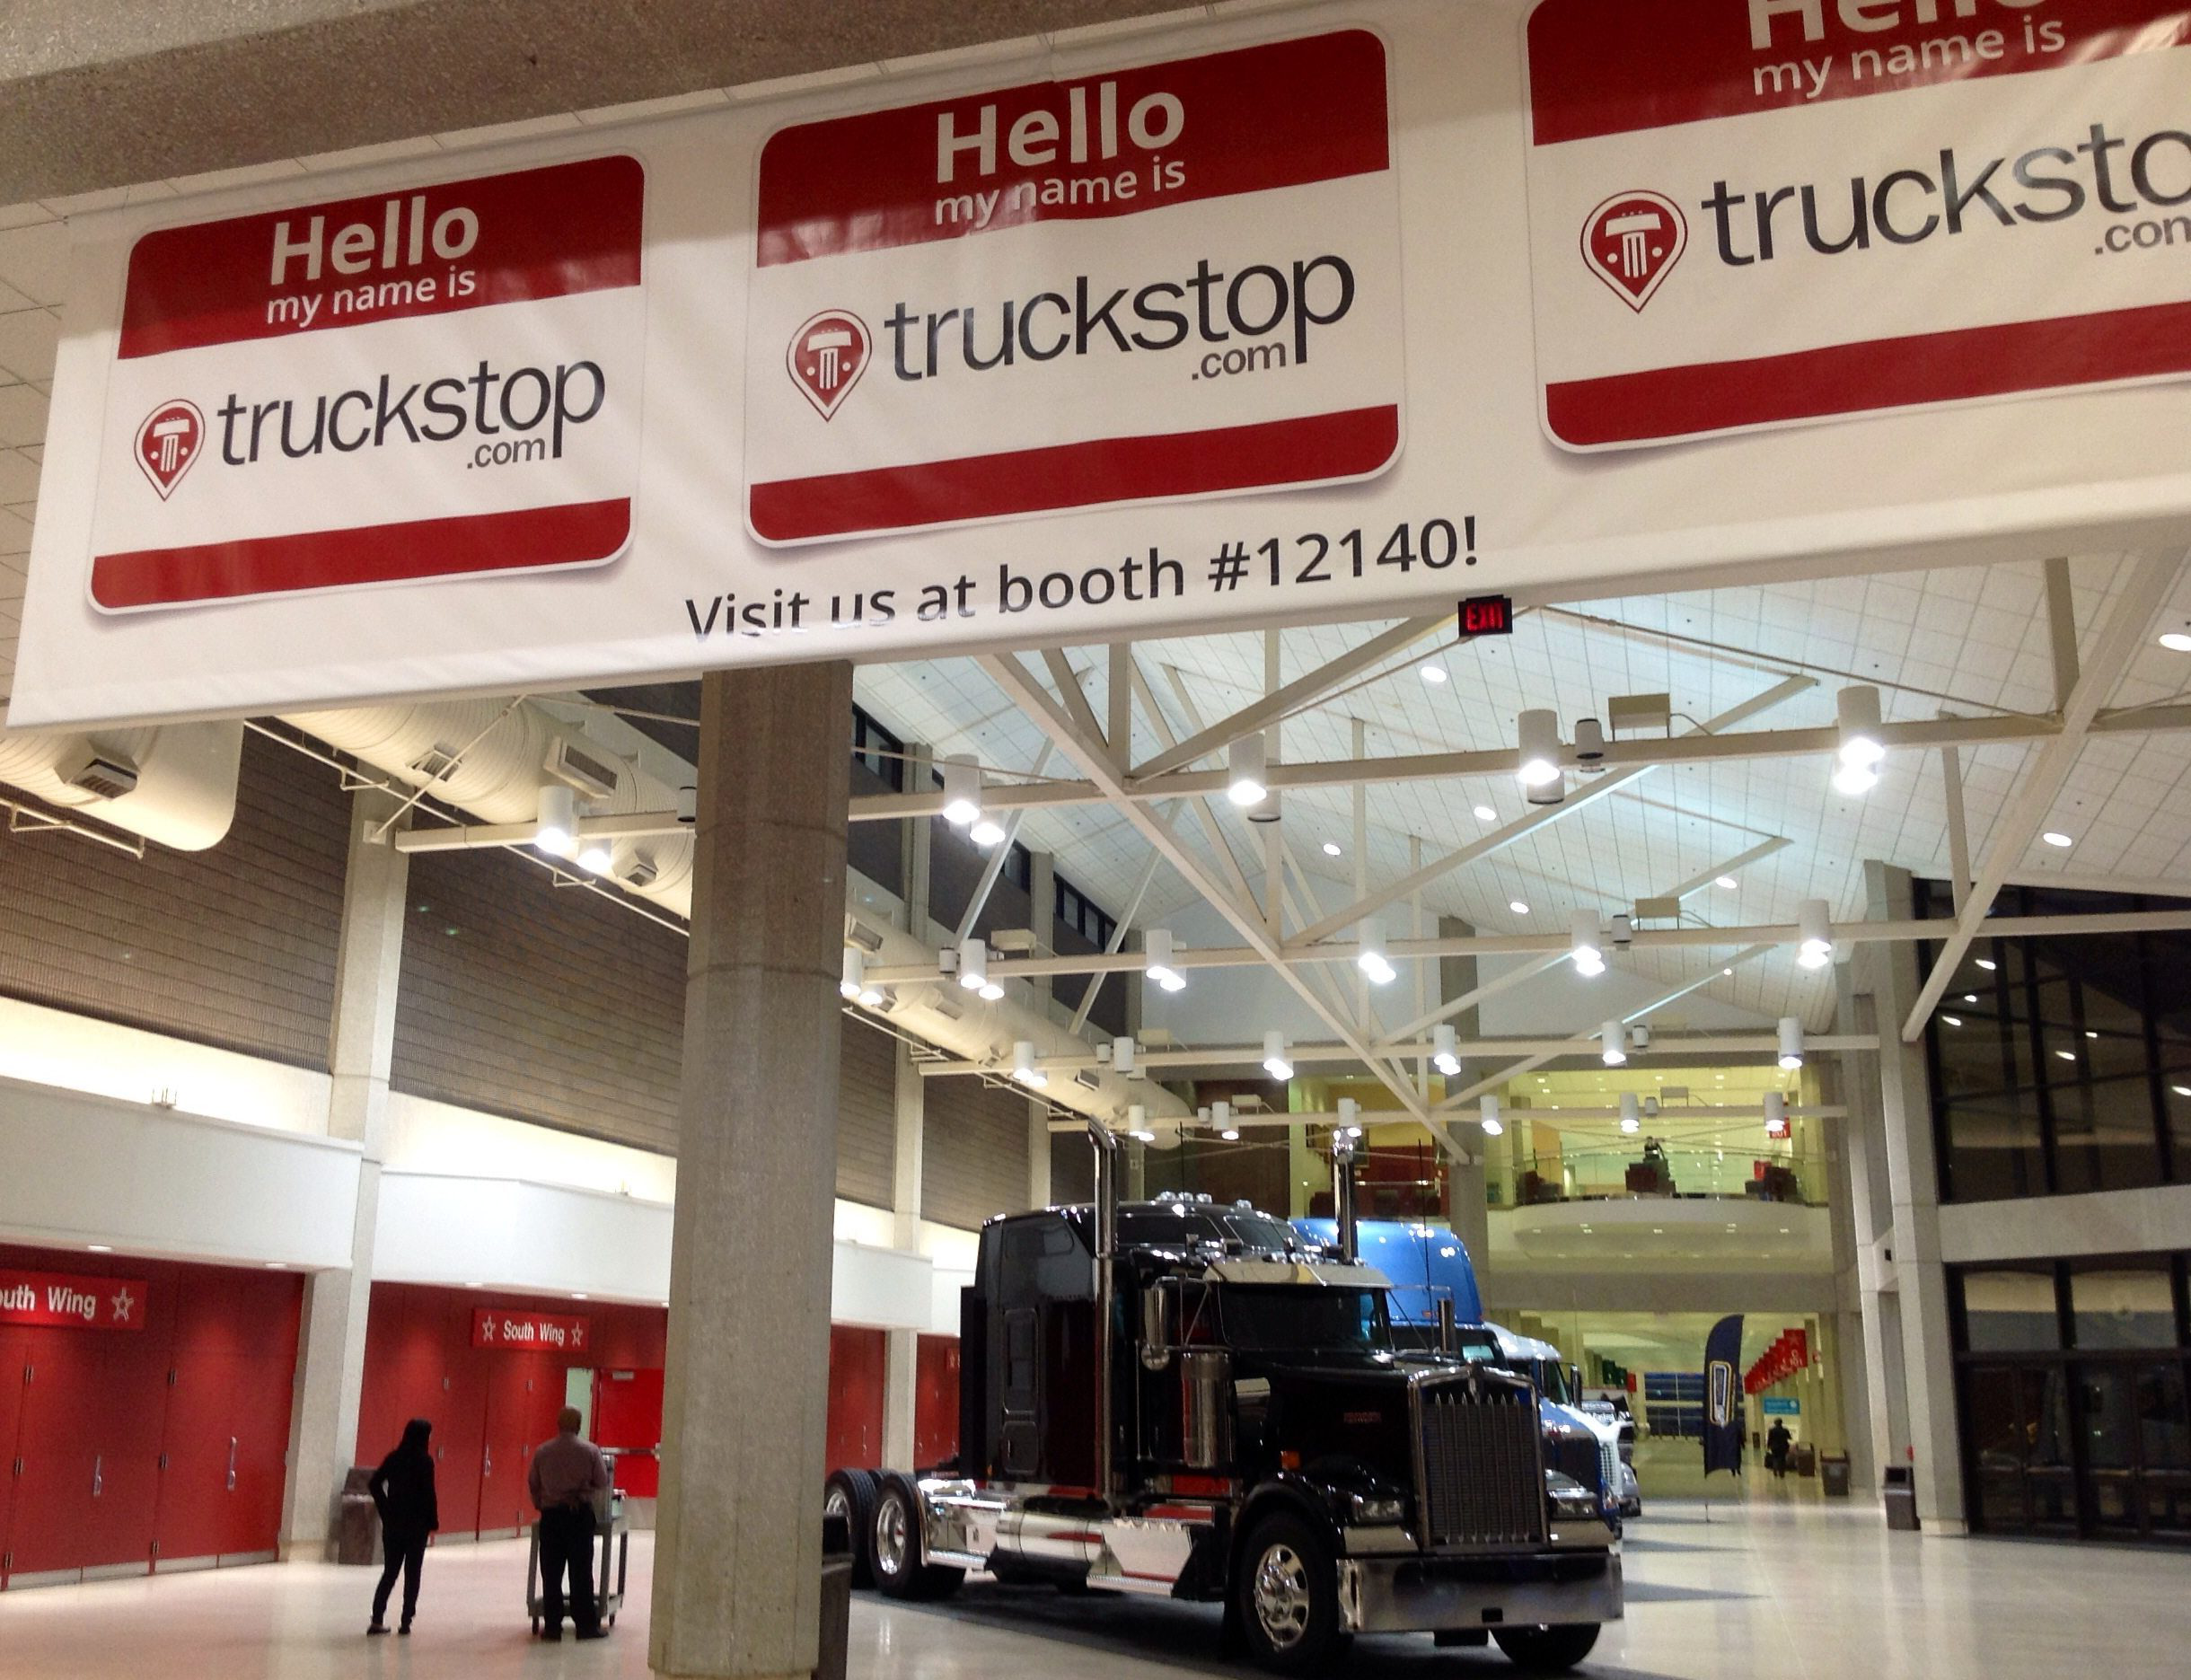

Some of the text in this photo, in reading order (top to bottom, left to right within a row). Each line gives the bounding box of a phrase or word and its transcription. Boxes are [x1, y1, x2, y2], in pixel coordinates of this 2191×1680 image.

[1754, 55, 1833, 99] my
[1852, 29, 2004, 80] name
[2023, 15, 2066, 54] is
[937, 81, 1185, 183] Hello
[935, 155, 1187, 228] my name is
[270, 196, 480, 286] Hello
[267, 266, 477, 327] my name is
[884, 255, 1356, 382] truckstop
[1192, 342, 1287, 380] .com
[217, 361, 605, 465] truckstop
[467, 435, 546, 470] .com
[685, 515, 1478, 643] Visit us at booth #12140!
[0, 1284, 96, 1321] uth Wing
[503, 1319, 565, 1347] South Wing
